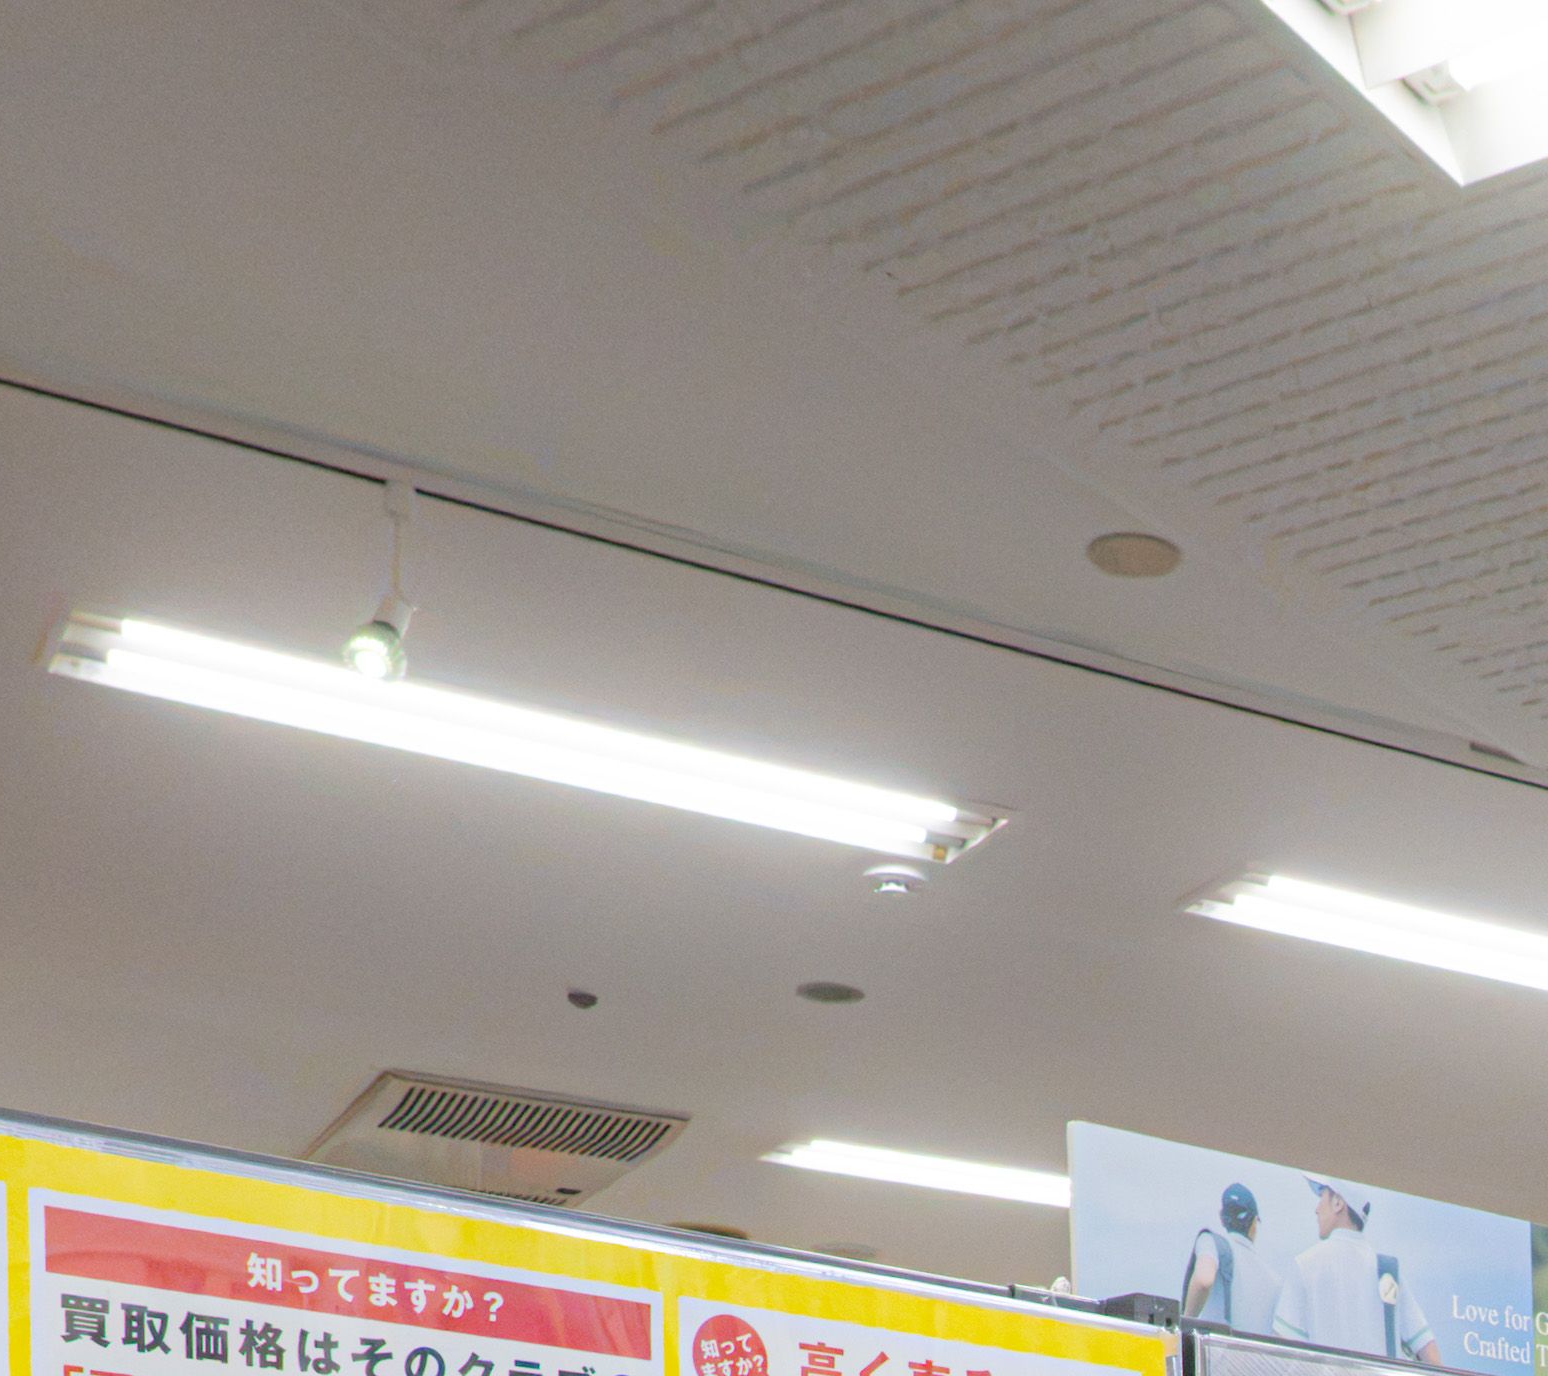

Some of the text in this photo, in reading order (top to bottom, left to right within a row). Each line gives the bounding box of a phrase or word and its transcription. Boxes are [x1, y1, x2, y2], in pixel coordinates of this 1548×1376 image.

[247, 1251, 504, 1323] 知ってますか?
[1451, 1295, 1499, 1326] Love
[1503, 1302, 1532, 1330] for
[700, 1333, 753, 1359] 知って
[1463, 1331, 1531, 1366] Crafted
